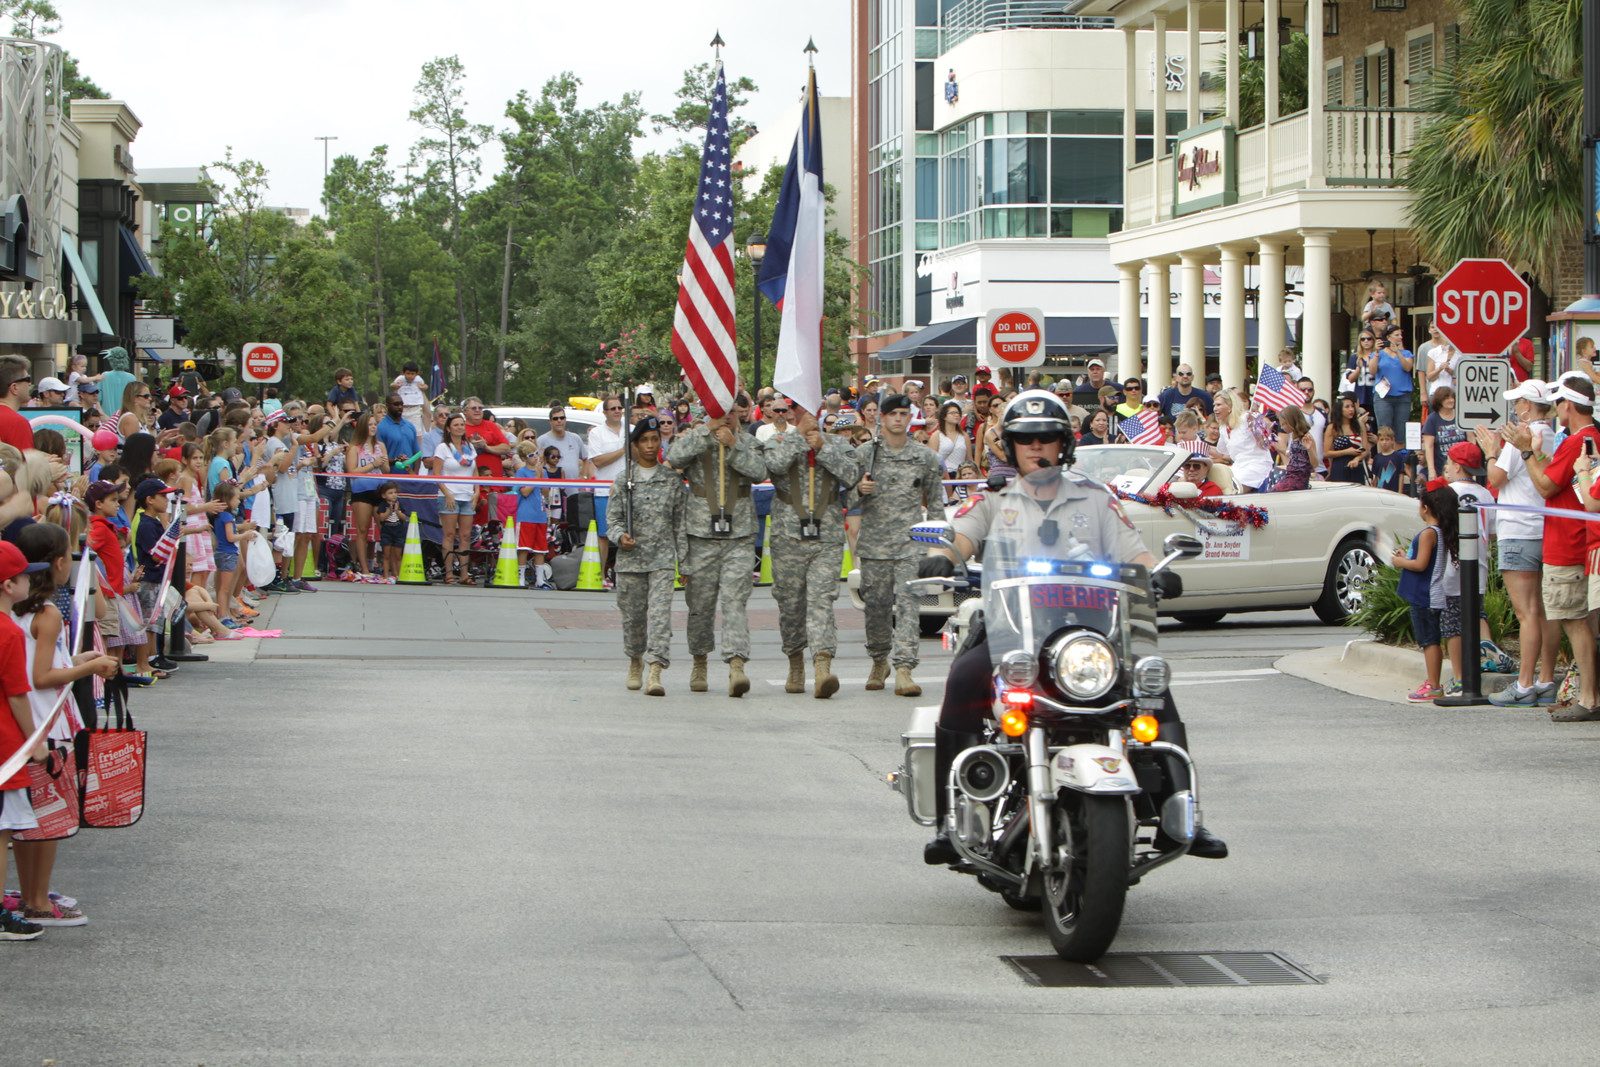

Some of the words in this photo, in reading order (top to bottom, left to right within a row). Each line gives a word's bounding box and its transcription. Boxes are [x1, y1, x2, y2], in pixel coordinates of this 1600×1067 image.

[1441, 289, 1523, 325] STOP
[998, 322, 1010, 331] DO
[1015, 322, 1032, 331] NOT
[1002, 343, 1029, 352] ENTER
[1465, 366, 1499, 382] ONE
[1465, 386, 1499, 402] WAY
[1205, 550, 1220, 558] Grand
[1031, 584, 1119, 612] SHERIFF
[98, 743, 135, 763] friends
[101, 766, 130, 780] money
